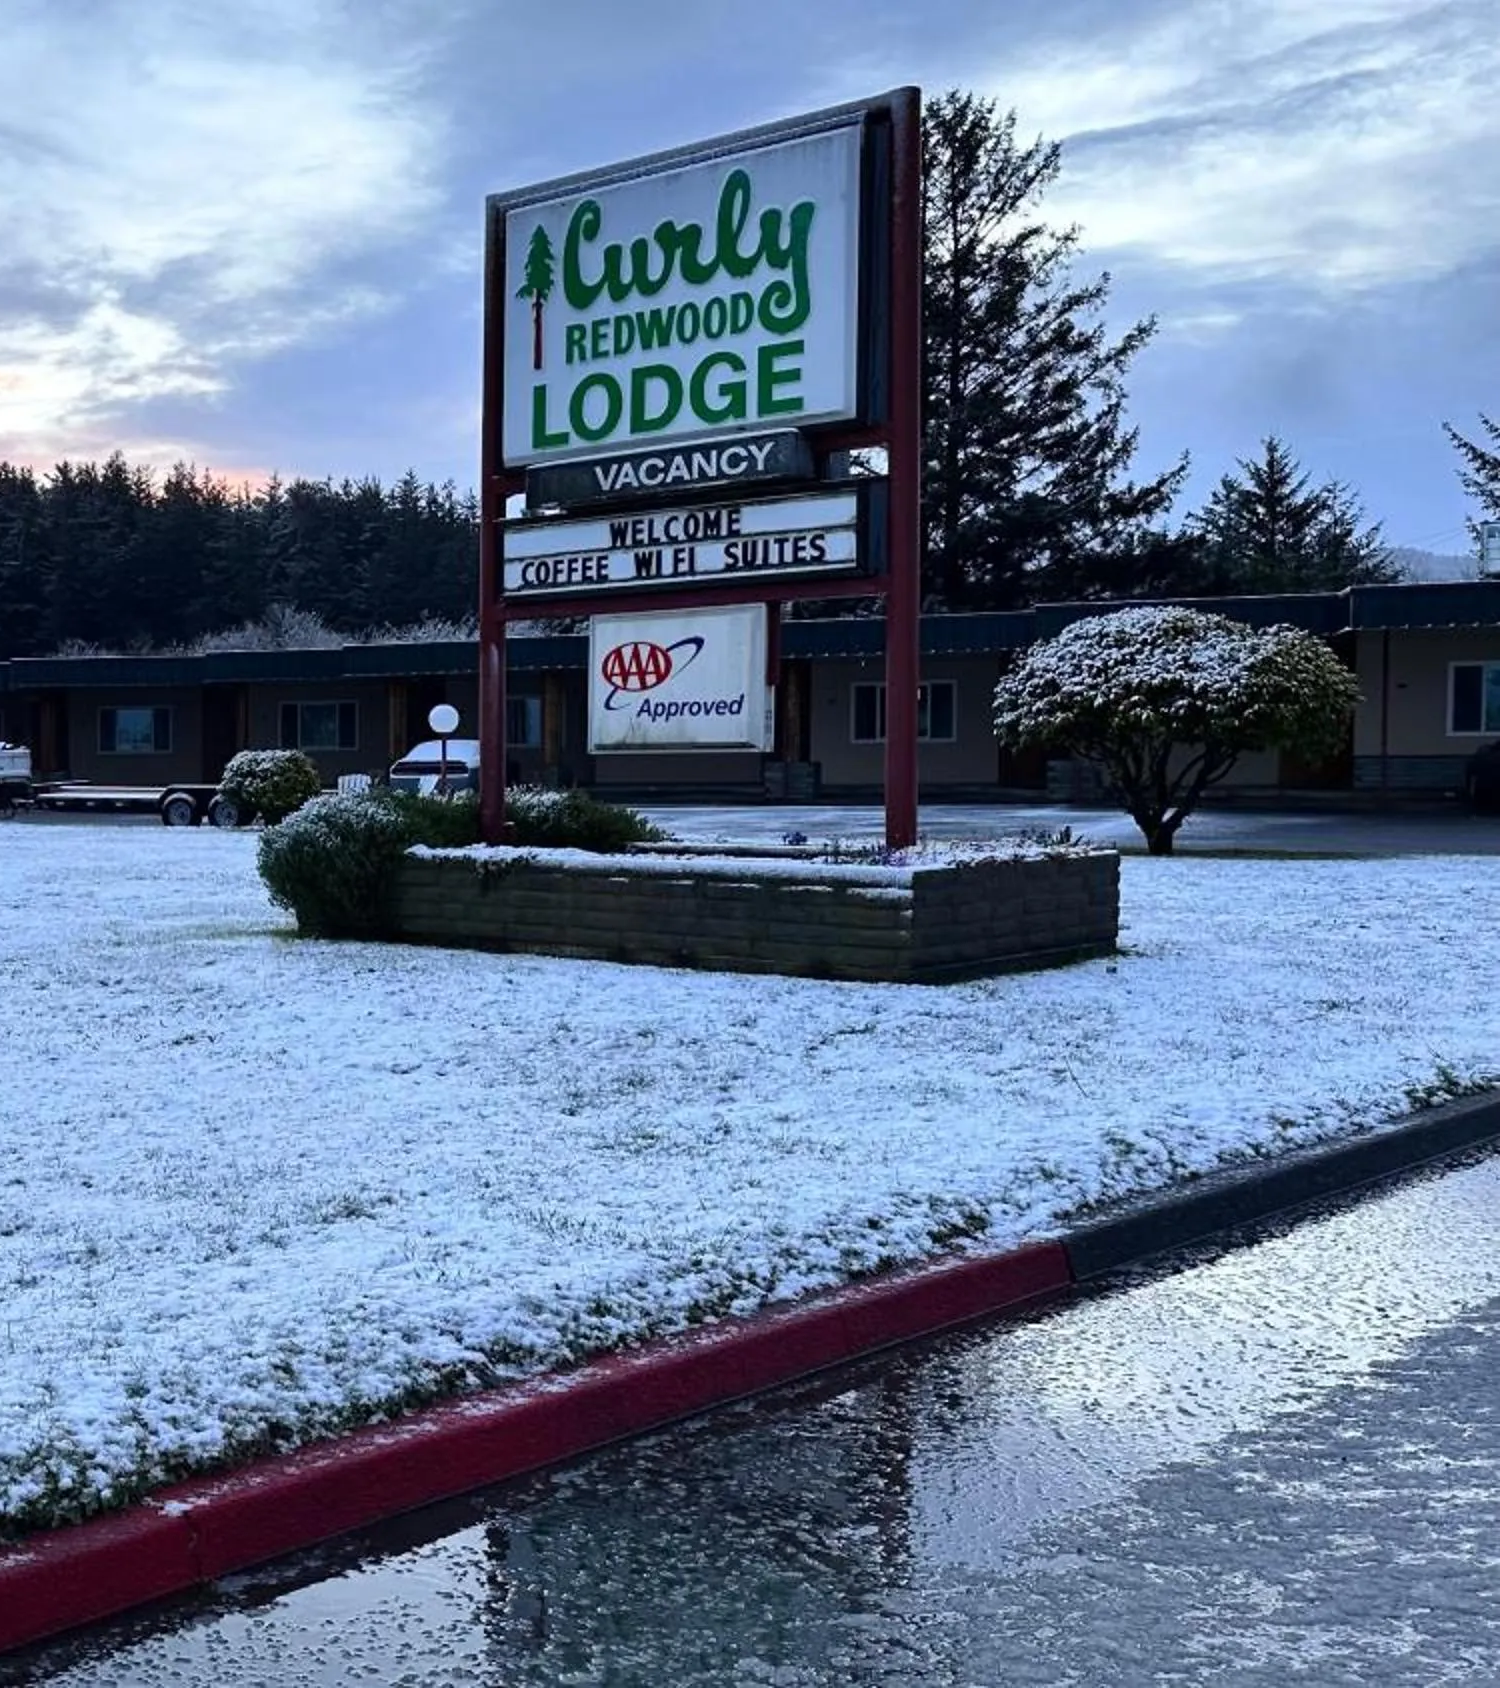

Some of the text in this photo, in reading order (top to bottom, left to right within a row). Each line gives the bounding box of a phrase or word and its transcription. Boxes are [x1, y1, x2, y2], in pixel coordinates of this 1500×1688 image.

[563, 169, 815, 333] Curly
[565, 292, 754, 364] REDWOOD
[532, 340, 804, 449] LODGE
[595, 442, 775, 491] VACANCY
[610, 509, 741, 547] WELCOME
[522, 555, 609, 586] COFFEE
[724, 534, 826, 568] SUITES
[605, 642, 669, 690] AAA
[637, 694, 744, 723] Approved
